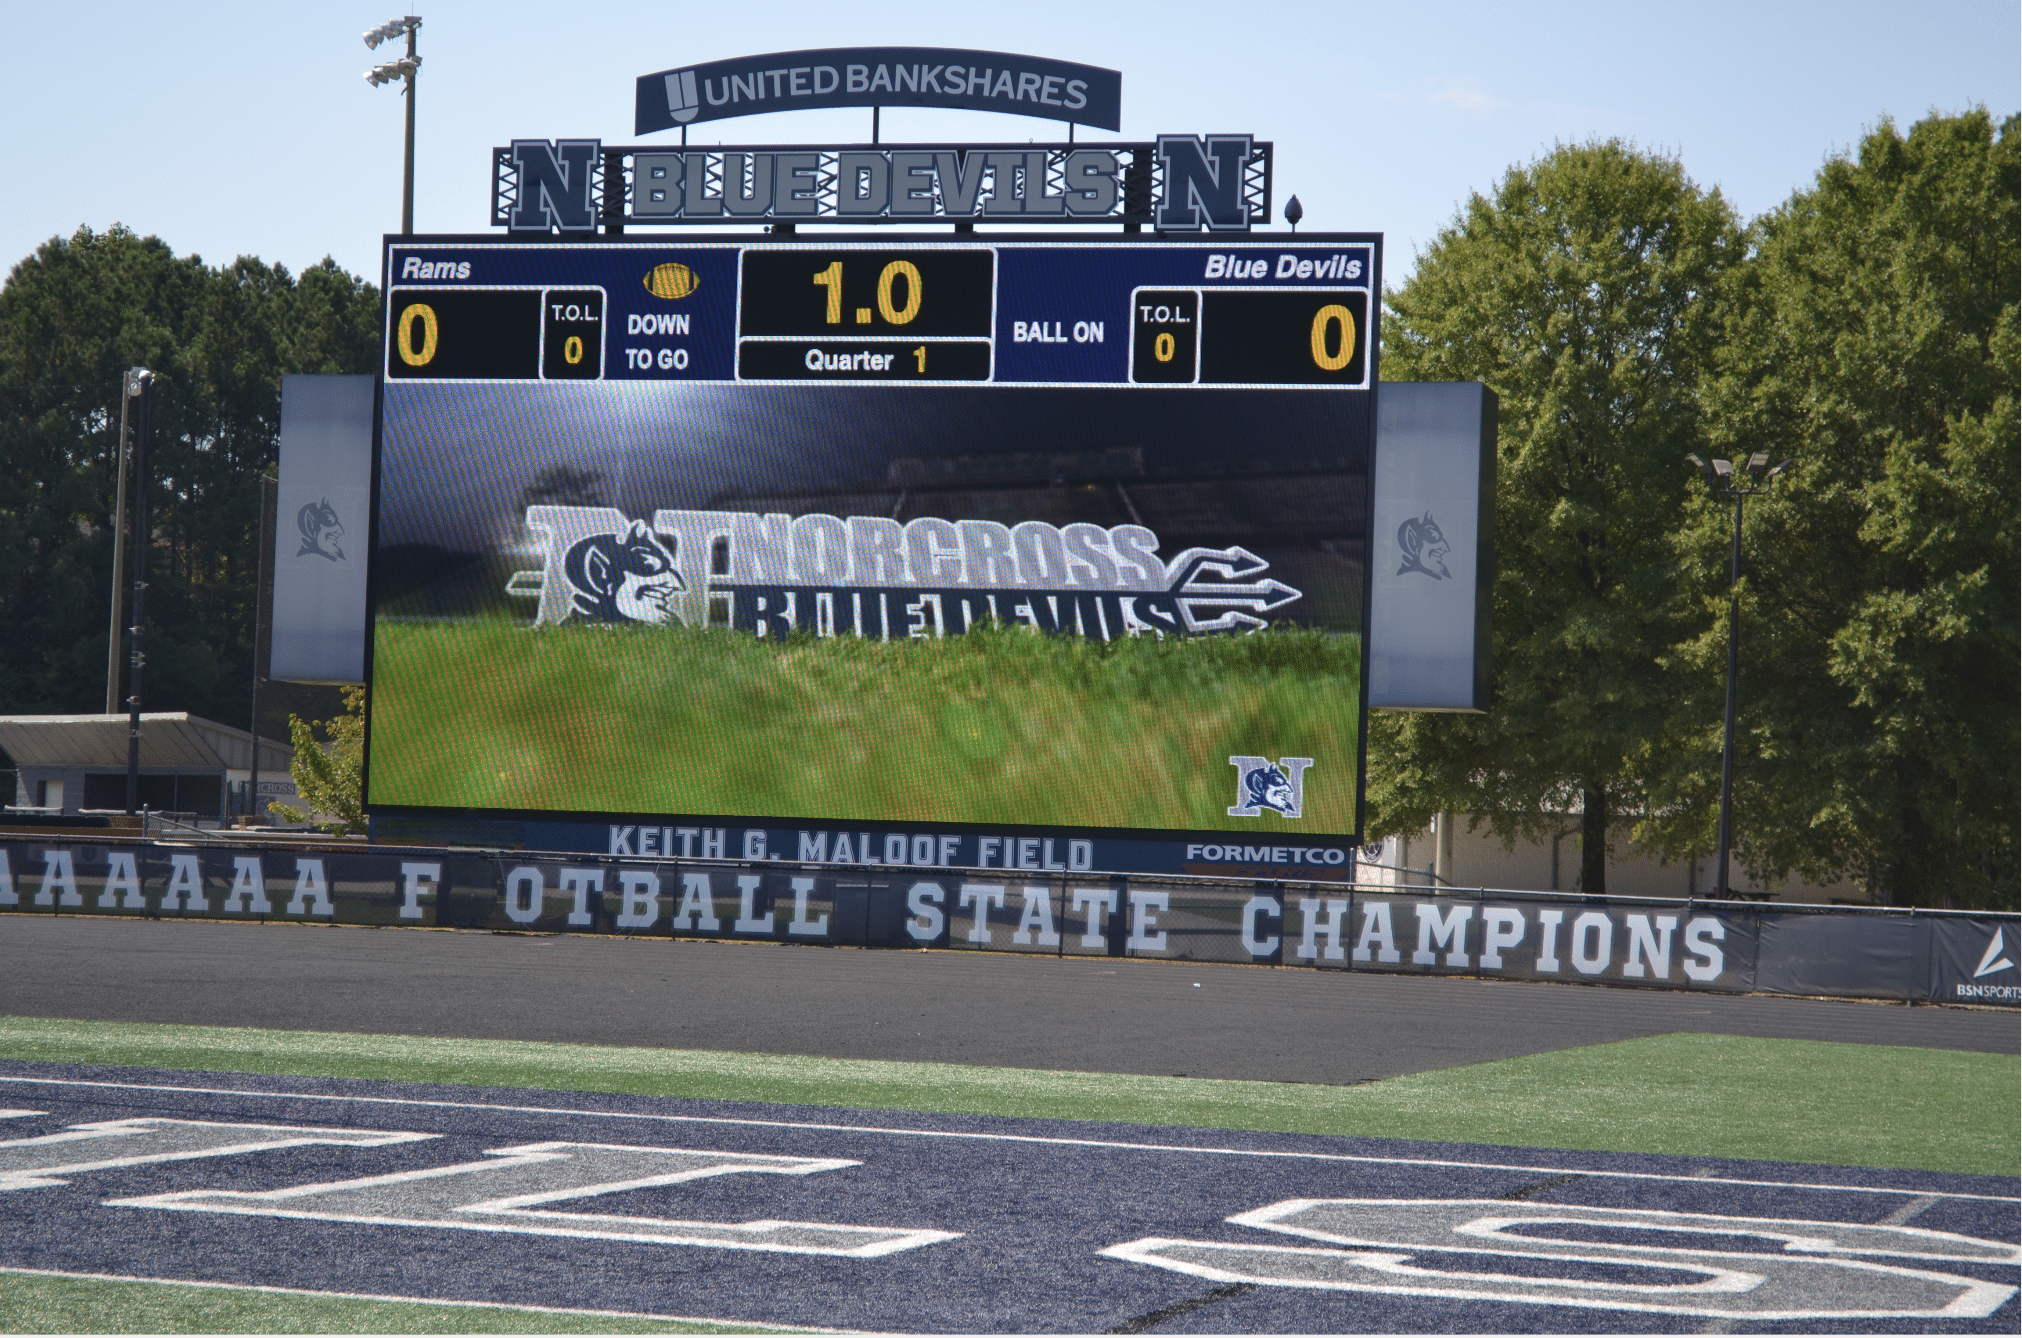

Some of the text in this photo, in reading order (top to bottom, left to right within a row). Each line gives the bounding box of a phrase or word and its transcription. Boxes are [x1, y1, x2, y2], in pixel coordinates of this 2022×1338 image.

[704, 63, 1089, 109] UNITED BANKSHARES
[511, 139, 600, 231] N
[631, 149, 1121, 219] BLUE DEVILS
[1156, 135, 1251, 229] N
[401, 256, 472, 279] Rams
[1204, 254, 1362, 279] Blue Devils
[813, 260, 923, 325] 1.0
[551, 304, 599, 321] T.O.L.
[627, 314, 690, 335] DOWN
[1140, 305, 1190, 323] T.O.L.
[397, 303, 438, 367] 0
[1013, 321, 1104, 343] BALL ON
[1154, 332, 1175, 362] 0
[1311, 304, 1356, 371] 0
[564, 335, 583, 364] 0
[625, 348, 689, 370] TO GO
[804, 345, 926, 373] Quarter 1
[732, 511, 1168, 592] NORCROSS
[609, 824, 1094, 872] KEITH G. MALOOF FIELD
[1186, 843, 1345, 865] FORMETCO
[905, 882, 1170, 951] STATE
[1241, 895, 1726, 982] CHAMPIONS
